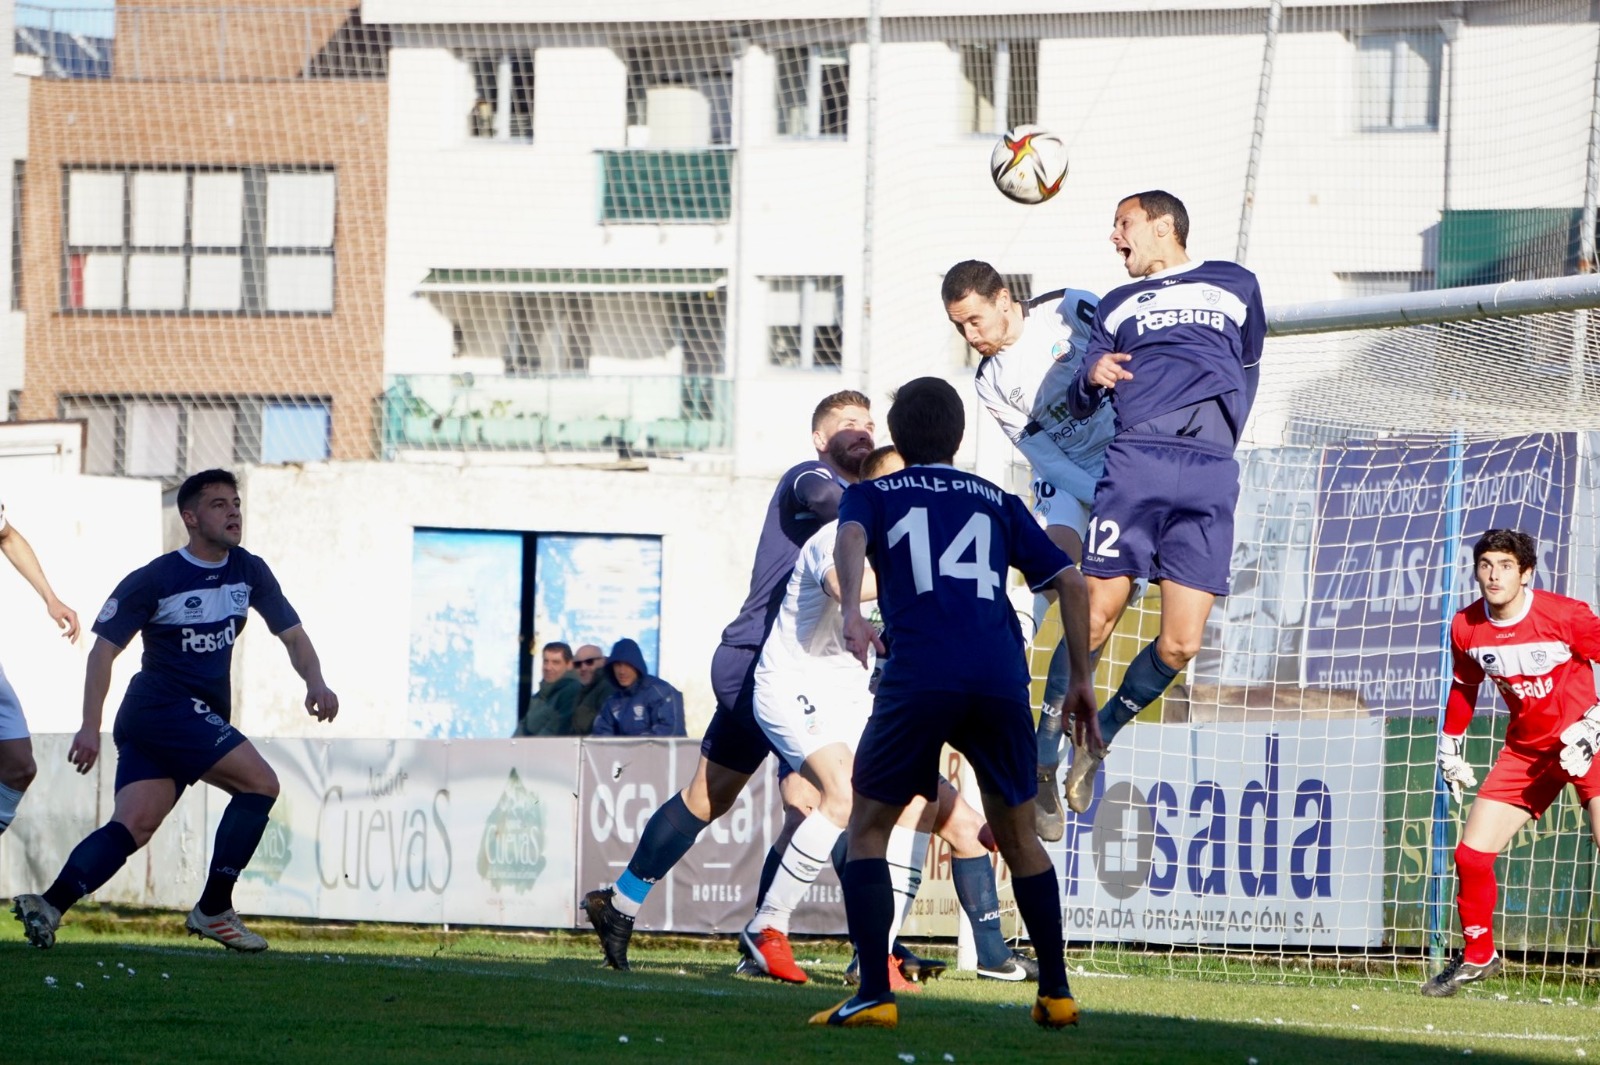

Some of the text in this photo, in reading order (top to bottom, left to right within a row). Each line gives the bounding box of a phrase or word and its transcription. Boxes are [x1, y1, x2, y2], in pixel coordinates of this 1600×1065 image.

[874, 475, 1003, 506] GUILLE PININ
[1341, 477, 1430, 517] TANATORIO
[886, 506, 1000, 601] 14
[1088, 516, 1120, 558] 12
[1370, 546, 1425, 612] LAS
[181, 618, 236, 653] Posad
[692, 884, 742, 902] HOTELS
[803, 885, 842, 903] OTELS
[1063, 906, 1331, 934] POSADA ORGANIZACIÓN S.A.
